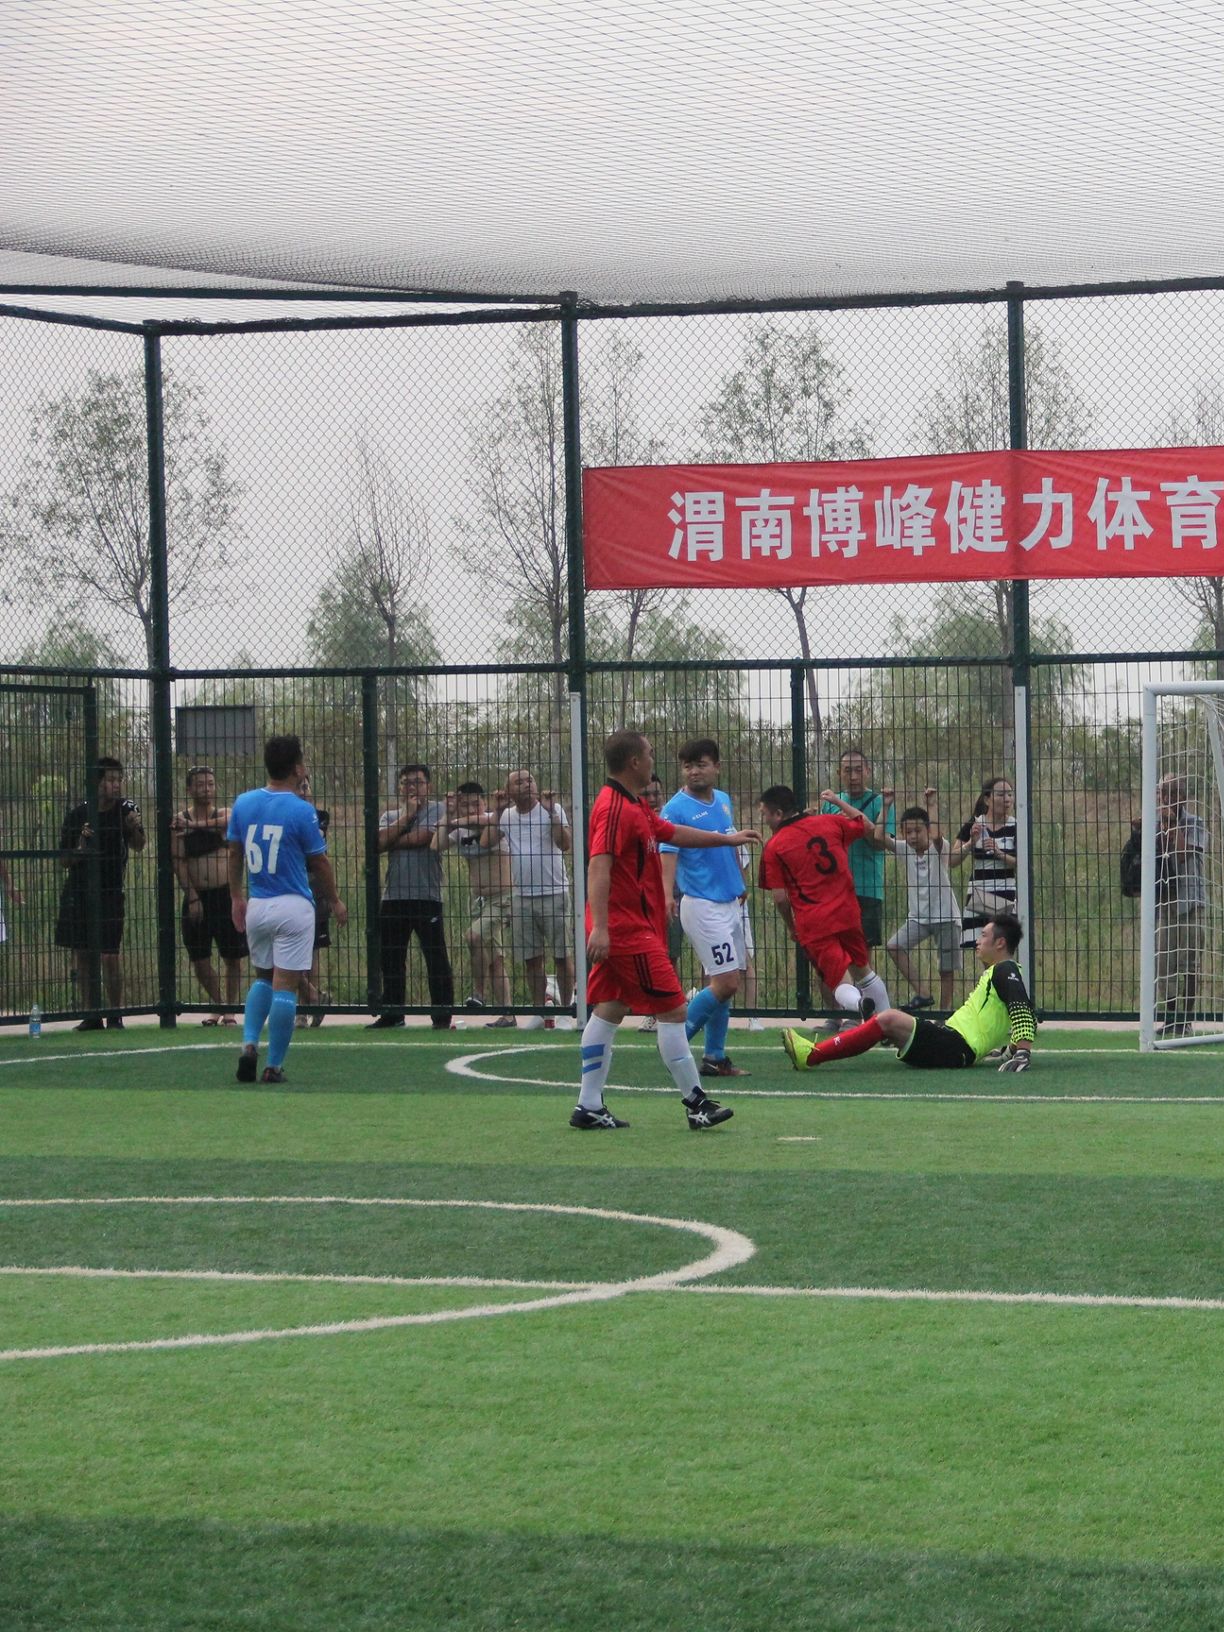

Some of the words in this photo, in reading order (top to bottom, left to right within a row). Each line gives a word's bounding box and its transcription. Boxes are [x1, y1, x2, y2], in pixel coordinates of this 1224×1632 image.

[245, 824, 284, 875] 67
[806, 836, 838, 876] 3
[711, 942, 735, 966] 52
